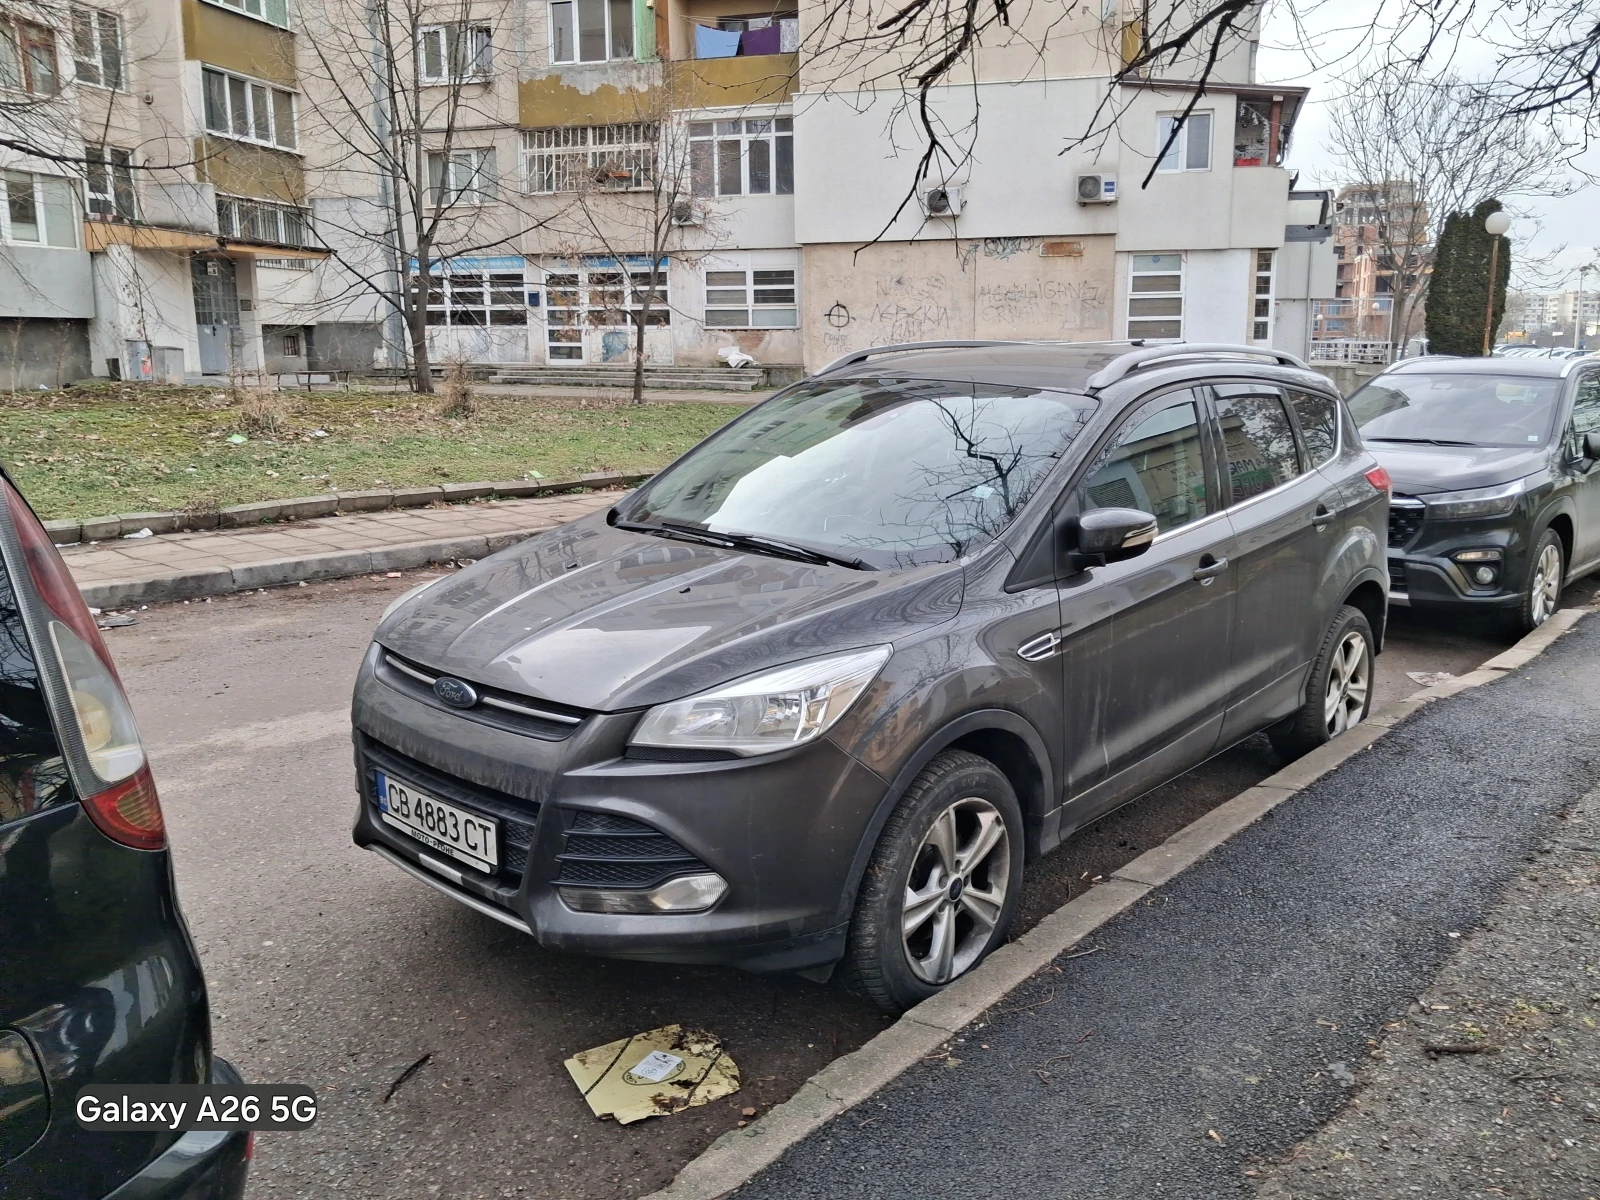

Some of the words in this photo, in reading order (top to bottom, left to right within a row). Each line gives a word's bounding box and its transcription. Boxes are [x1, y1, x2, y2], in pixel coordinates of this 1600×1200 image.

[439, 681, 463, 702] Ford
[388, 783, 410, 819] CB
[414, 797, 460, 843] 4883
[464, 818, 492, 857] CT
[410, 829, 455, 857] MOTO-PFOHE
